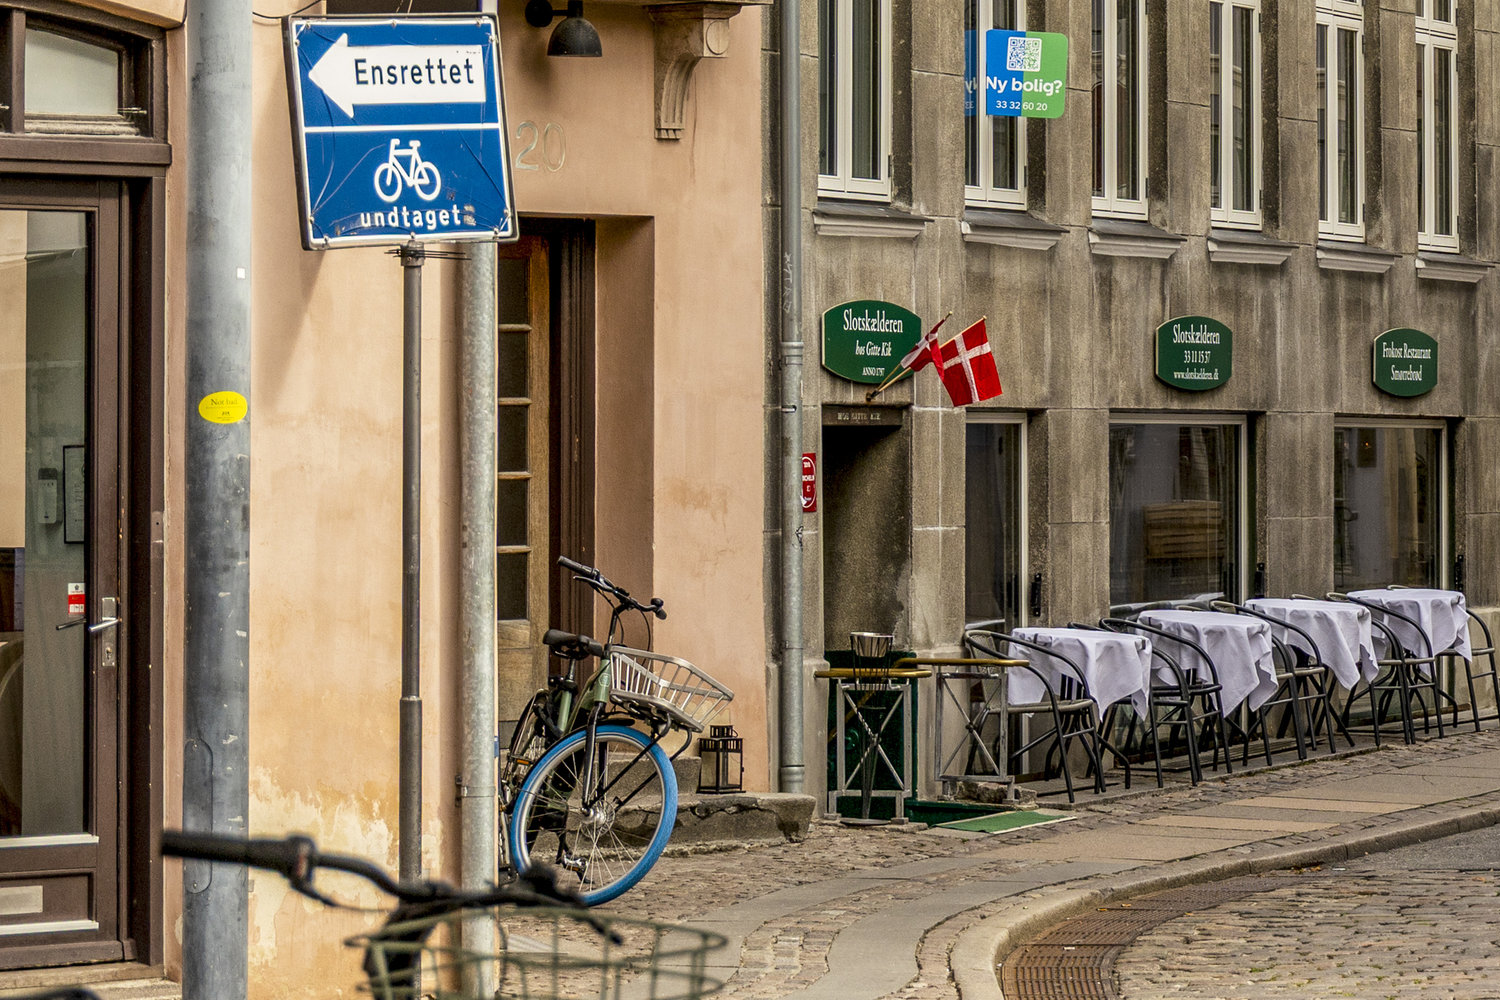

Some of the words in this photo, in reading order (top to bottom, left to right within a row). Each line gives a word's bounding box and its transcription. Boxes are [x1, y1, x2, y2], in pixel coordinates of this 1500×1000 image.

[354, 57, 475, 86] Ensrettet
[986, 76, 1008, 93] Ny
[1011, 78, 1063, 96] bolig?
[996, 101, 1007, 109] 33
[1009, 101, 1020, 109] 32
[1022, 102, 1034, 110] 60
[1036, 102, 1048, 111] 20
[515, 121, 567, 172] 20
[360, 204, 461, 230] undtaget
[843, 308, 904, 333] Slotskælderen
[1173, 324, 1220, 344] Slotskælderen
